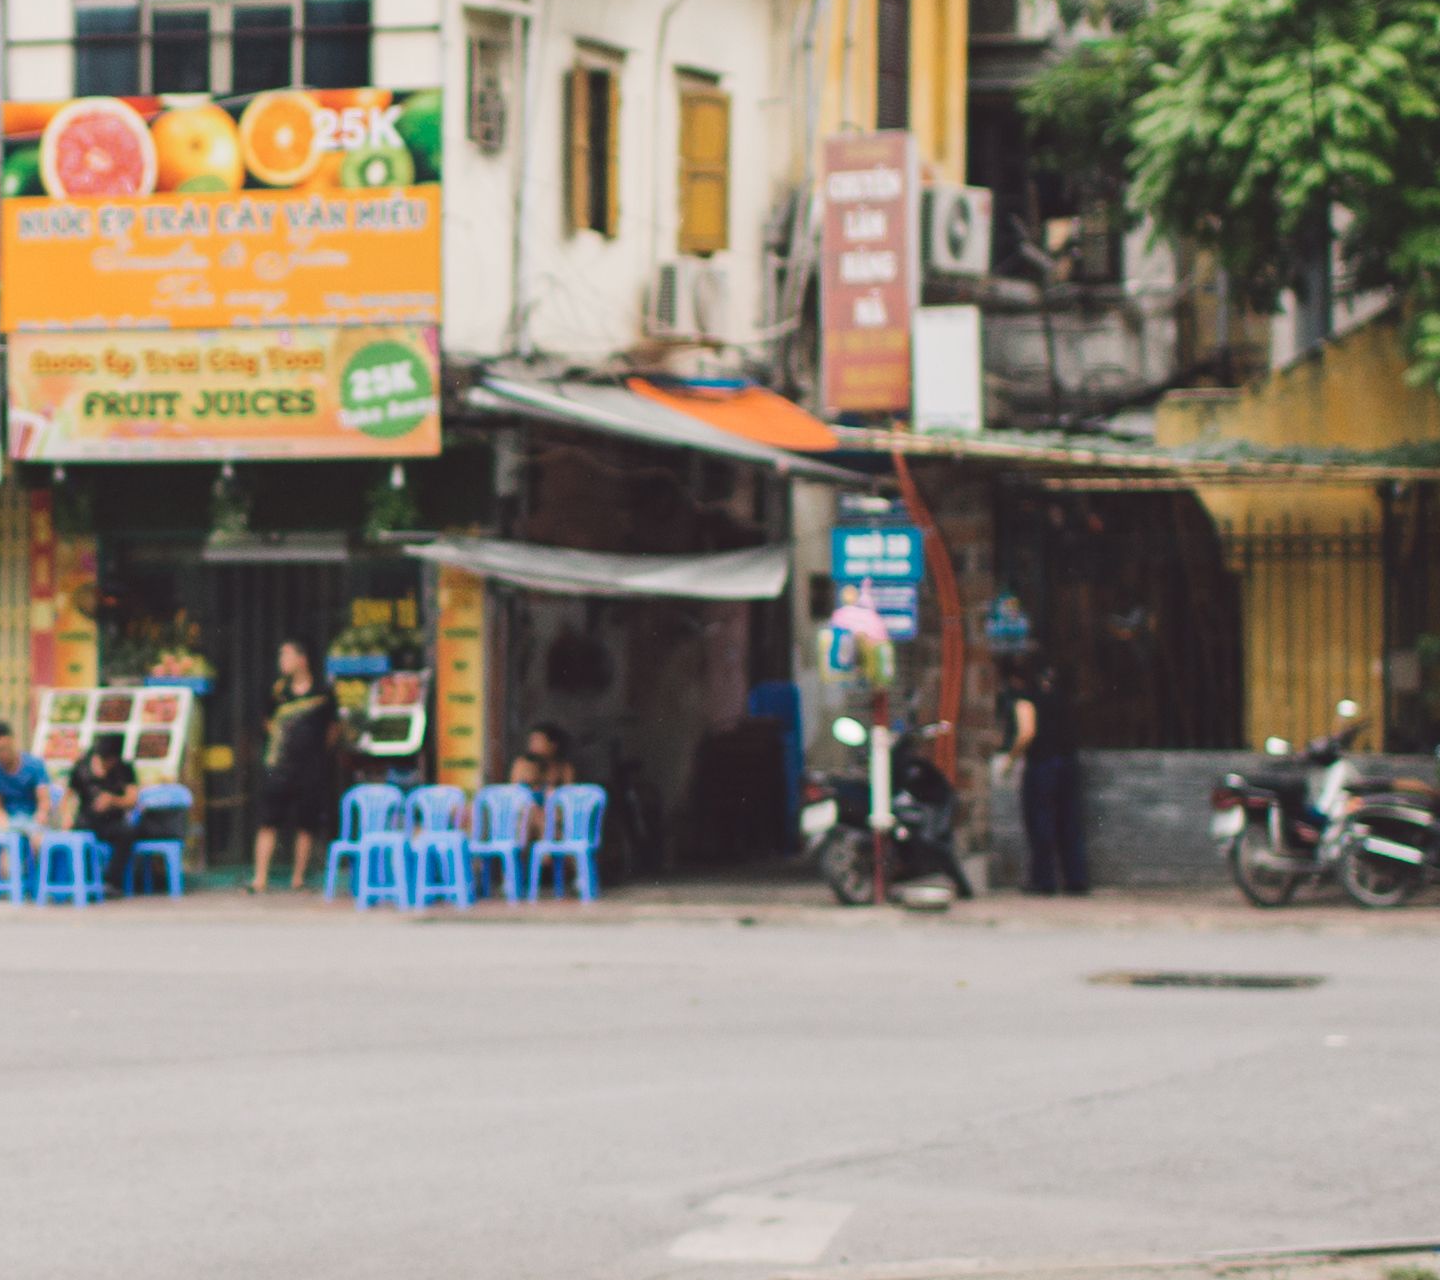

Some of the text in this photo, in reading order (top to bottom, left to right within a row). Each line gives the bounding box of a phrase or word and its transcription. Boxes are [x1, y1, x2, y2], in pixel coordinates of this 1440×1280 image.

[313, 105, 404, 151] 25K
[347, 360, 418, 403] 25K
[82, 389, 317, 419] FRUIT JUICES
